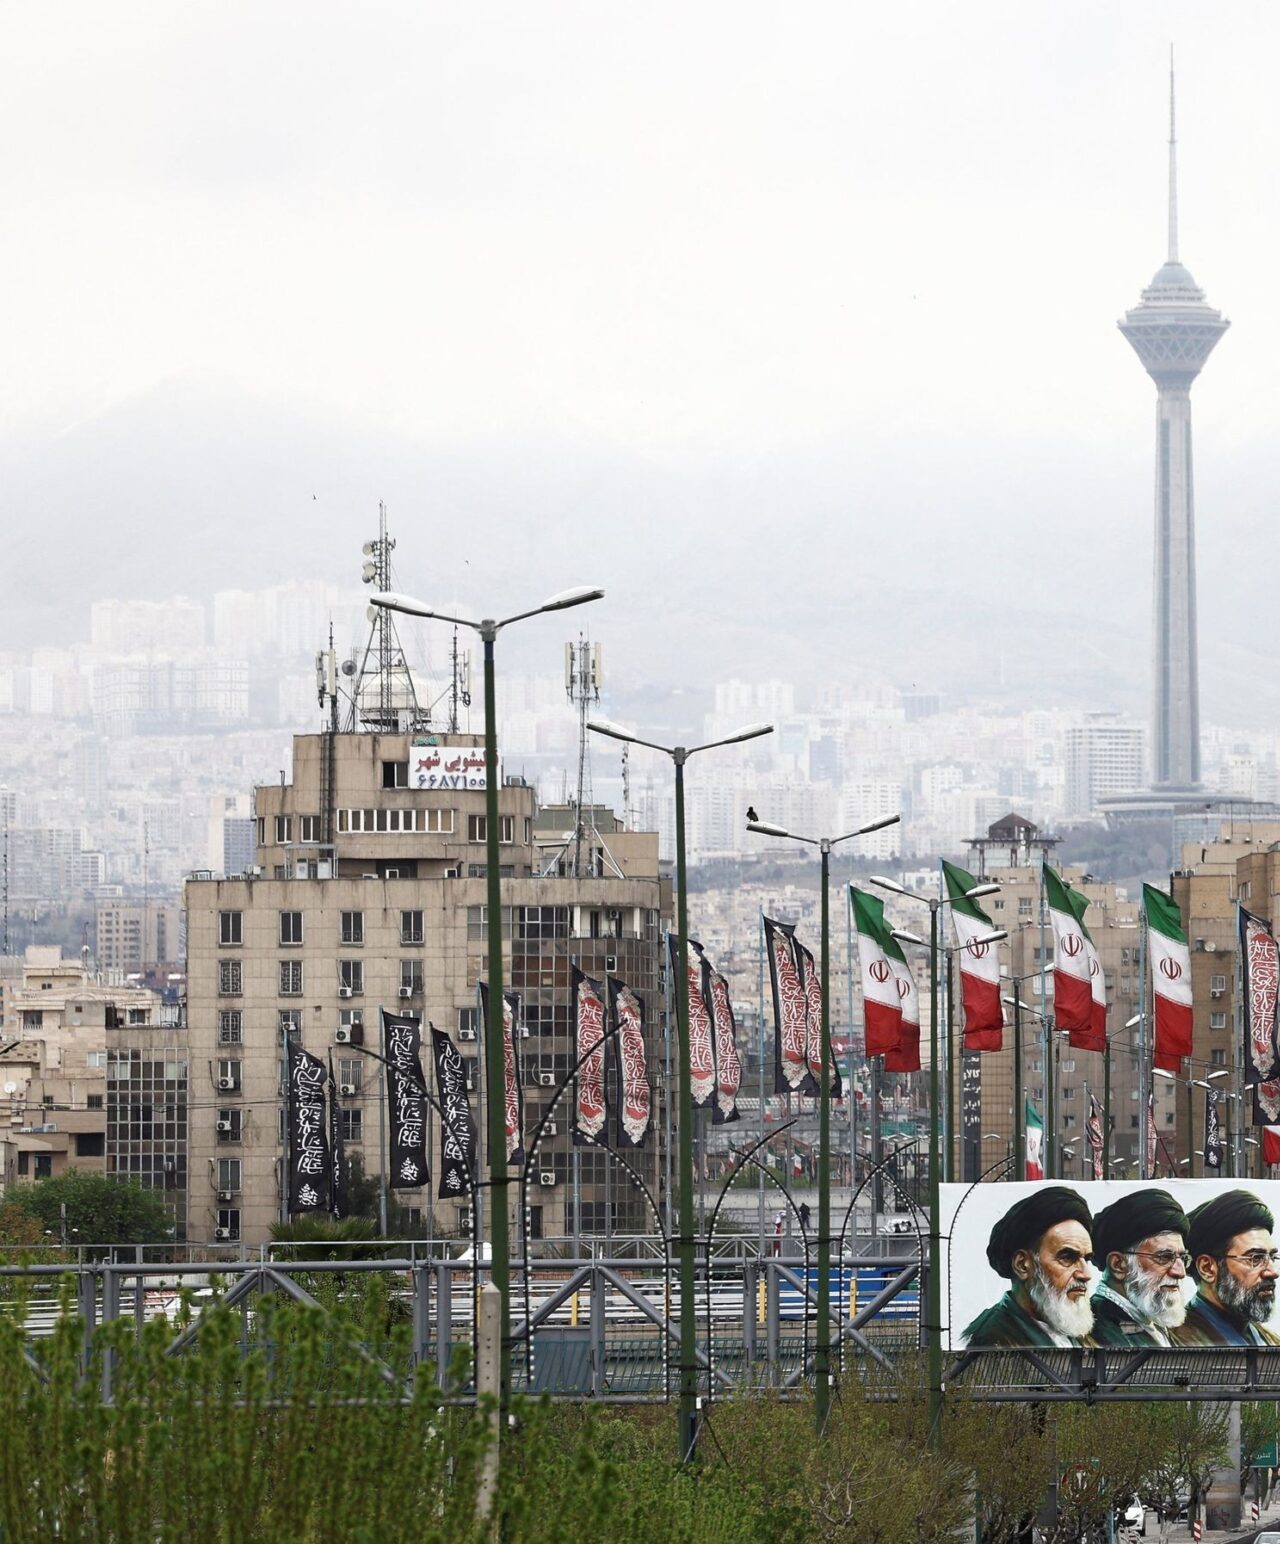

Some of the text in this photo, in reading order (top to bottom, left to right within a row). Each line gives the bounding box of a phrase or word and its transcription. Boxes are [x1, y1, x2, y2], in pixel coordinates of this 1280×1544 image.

[415, 749, 498, 773] لیشویی شهر
[418, 774, 487, 788] ۶۶۸۷۱۰۰
